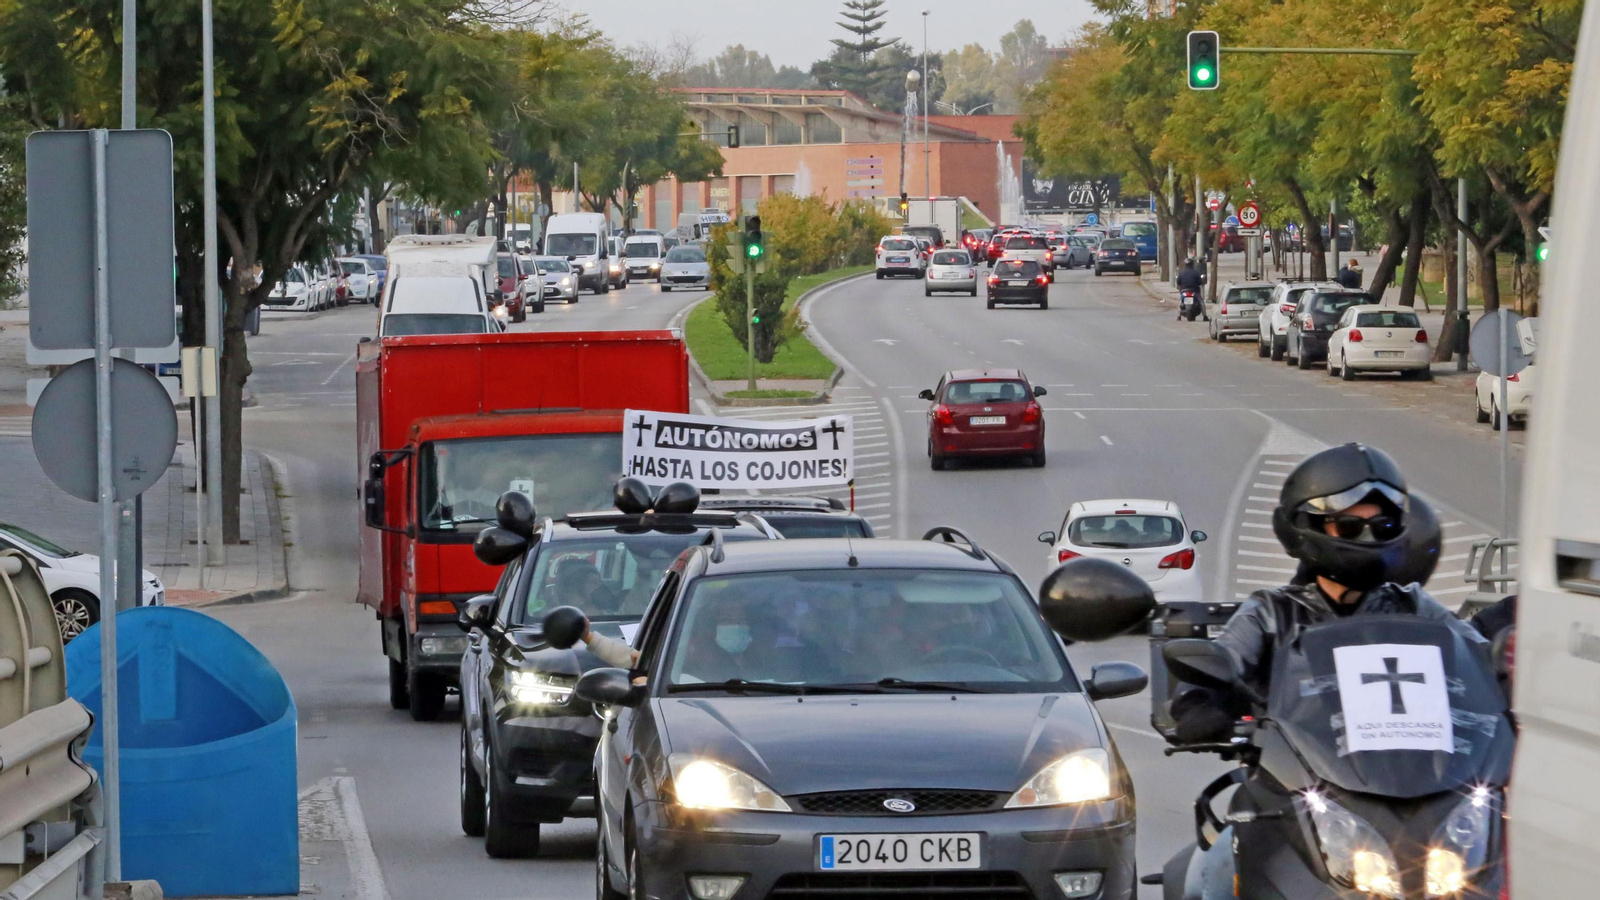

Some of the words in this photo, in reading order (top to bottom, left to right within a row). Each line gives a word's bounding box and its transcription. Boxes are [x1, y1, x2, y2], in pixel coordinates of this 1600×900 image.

[657, 426, 814, 449] AUTÓNOMOS
[628, 455, 694, 480] ¡HASTA
[701, 460, 739, 481] LOS
[746, 458, 848, 481] COJONES!
[1380, 731, 1442, 739] AUTONOMO
[1385, 721, 1444, 729] DESCANSA
[838, 839, 908, 864] 2040
[920, 838, 972, 863] CKB
